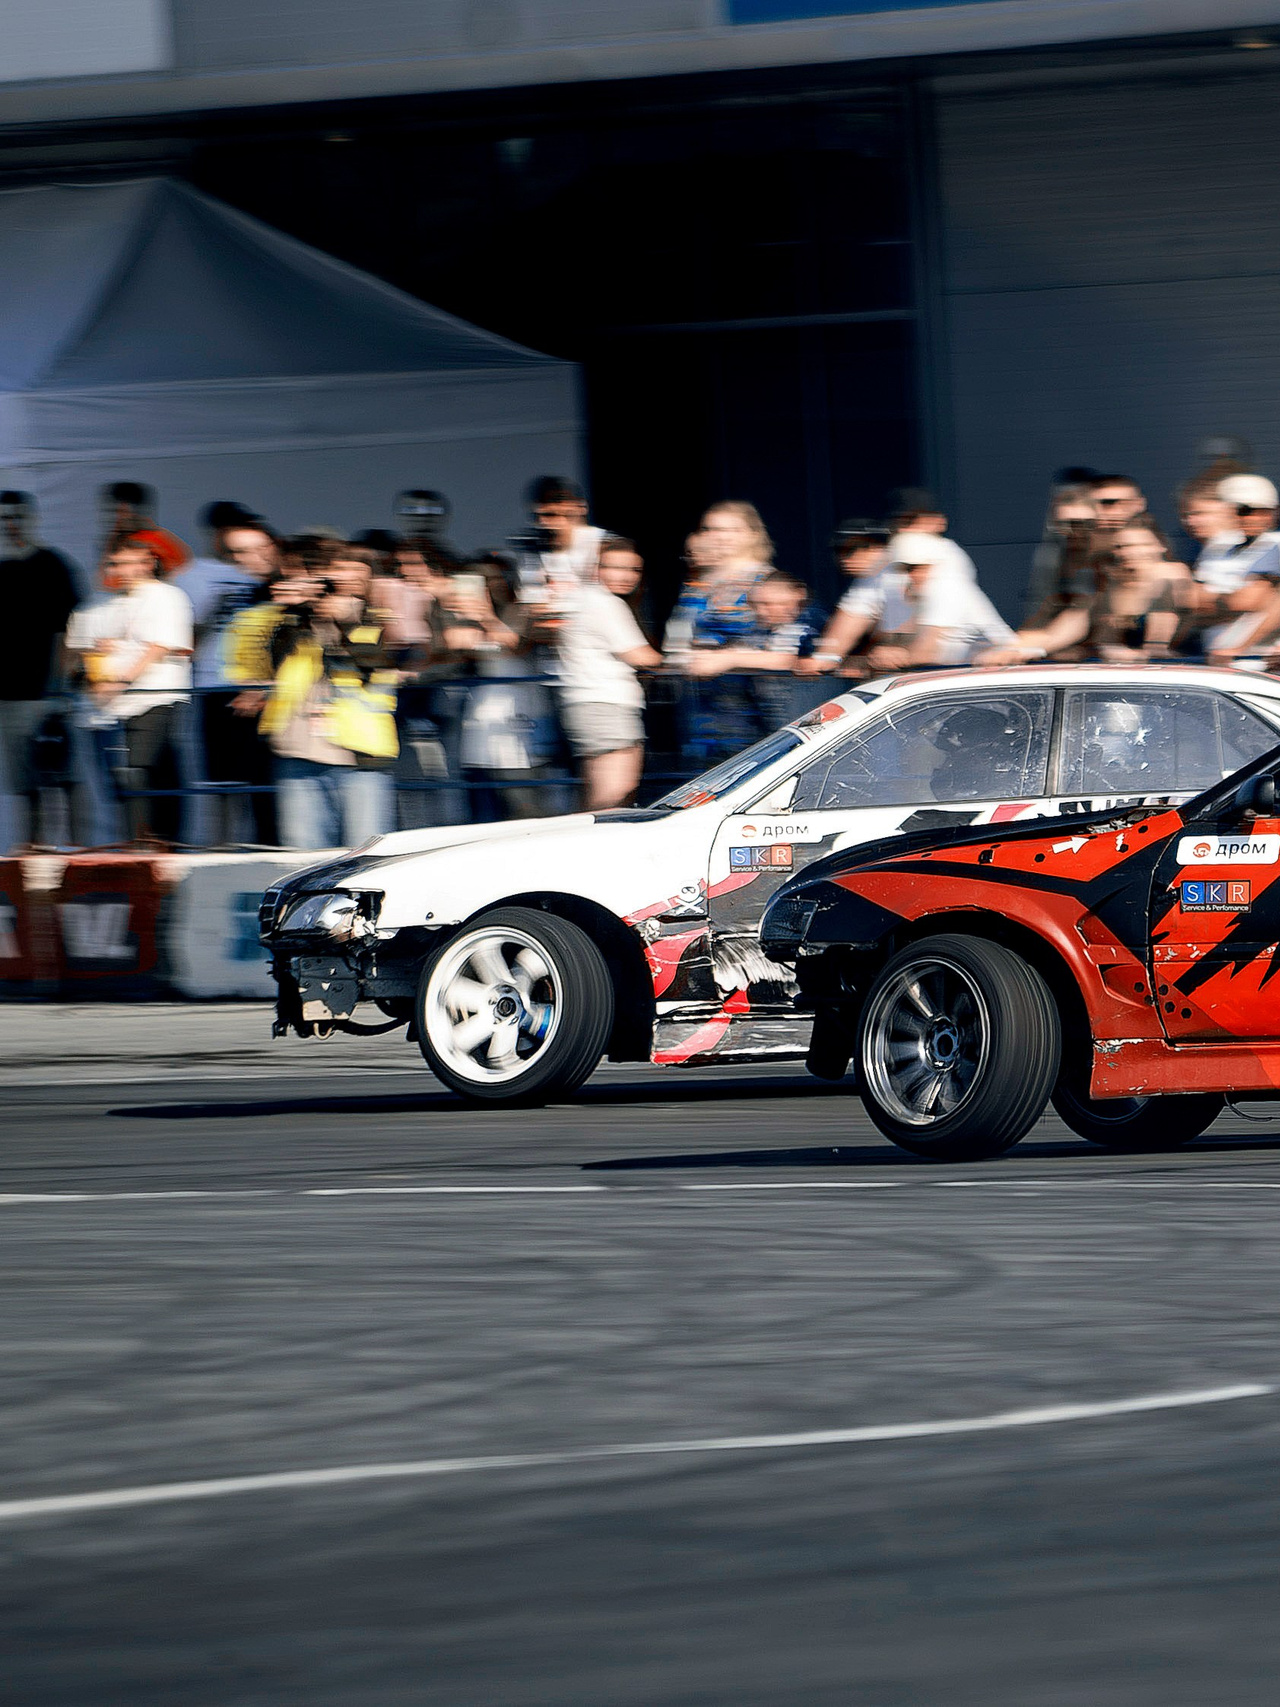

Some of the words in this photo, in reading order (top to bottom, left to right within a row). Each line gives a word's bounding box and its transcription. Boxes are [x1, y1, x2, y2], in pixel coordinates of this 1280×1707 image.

[763, 825, 809, 838] дром
[734, 848, 788, 864] SKR
[1215, 843, 1266, 859] дром
[1186, 884, 1245, 902] SKR
